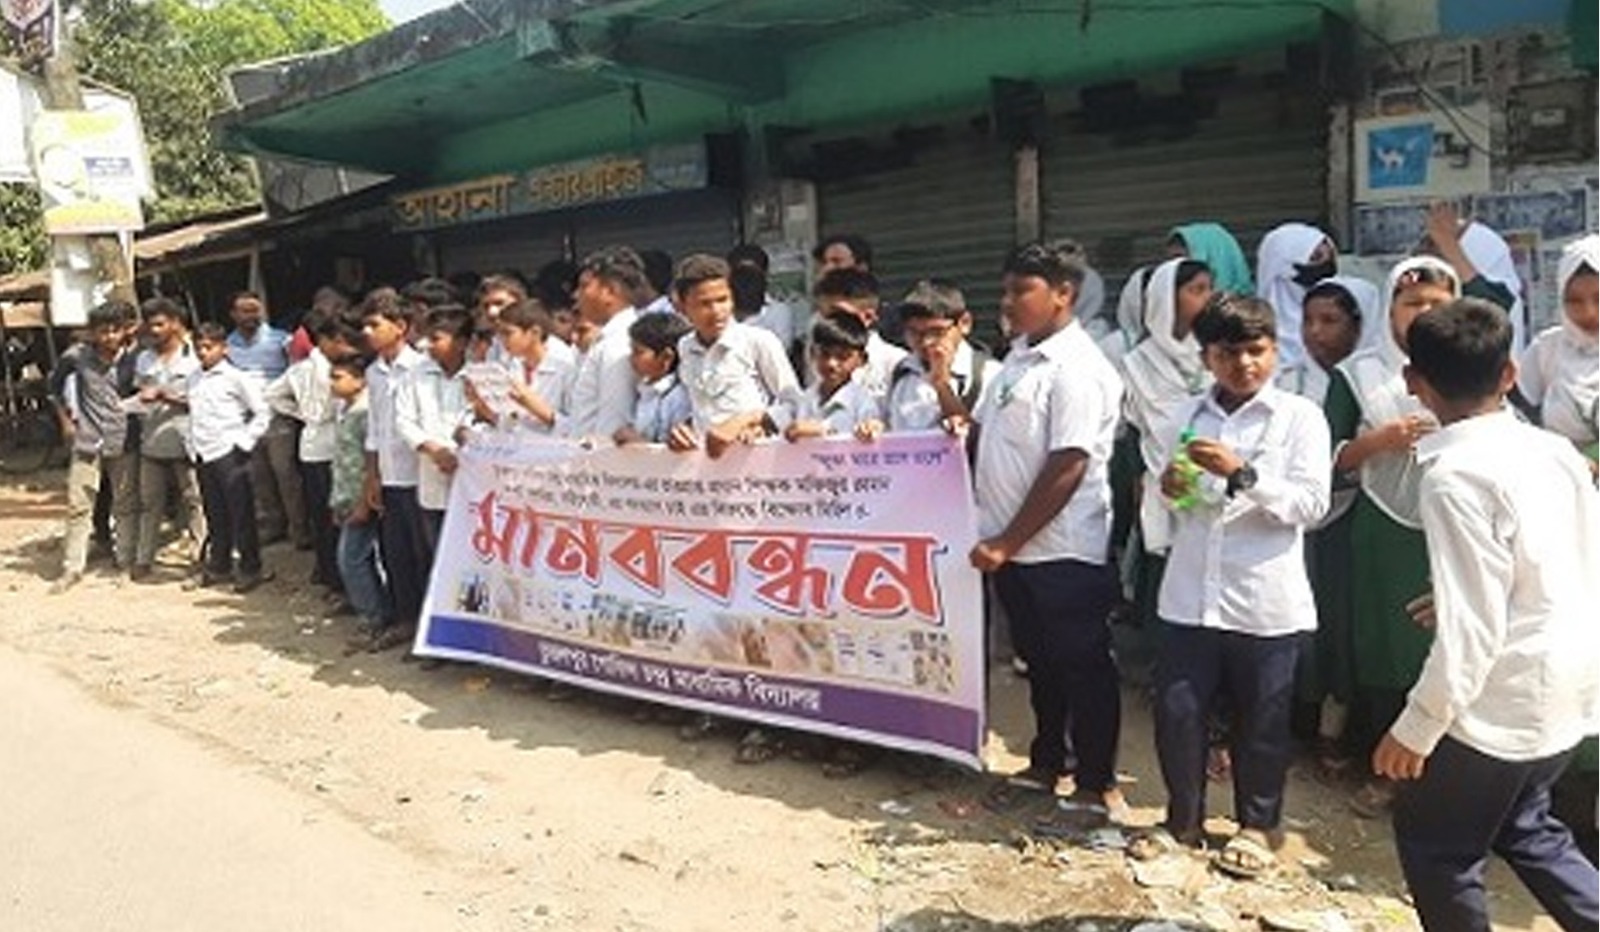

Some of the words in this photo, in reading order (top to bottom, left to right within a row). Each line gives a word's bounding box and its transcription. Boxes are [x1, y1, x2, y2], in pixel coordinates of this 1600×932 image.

[393, 171, 518, 228] আহানা
[469, 489, 948, 626] মানববন্ধন
[672, 668, 740, 697] মাধ্যমিক
[744, 672, 821, 711] বিদ্যালয়
